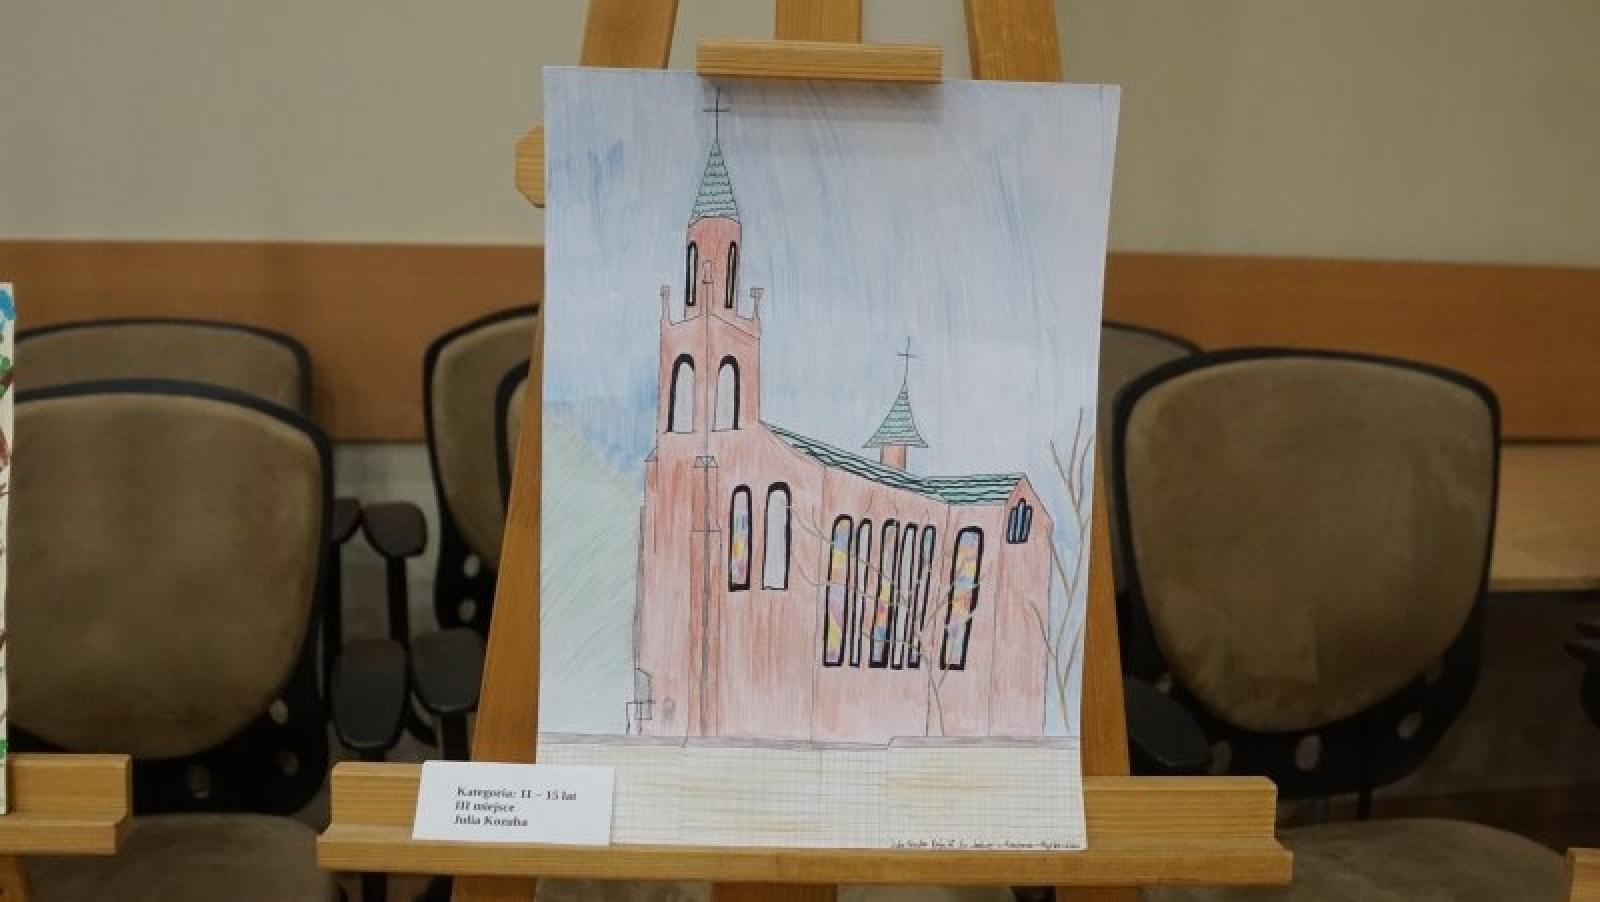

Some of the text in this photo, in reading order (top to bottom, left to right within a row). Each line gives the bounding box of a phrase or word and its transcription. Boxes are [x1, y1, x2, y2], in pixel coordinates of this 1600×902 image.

[457, 787, 516, 799] Kategoria:
[473, 803, 515, 814] miejsce
[454, 815, 481, 825] Julia
